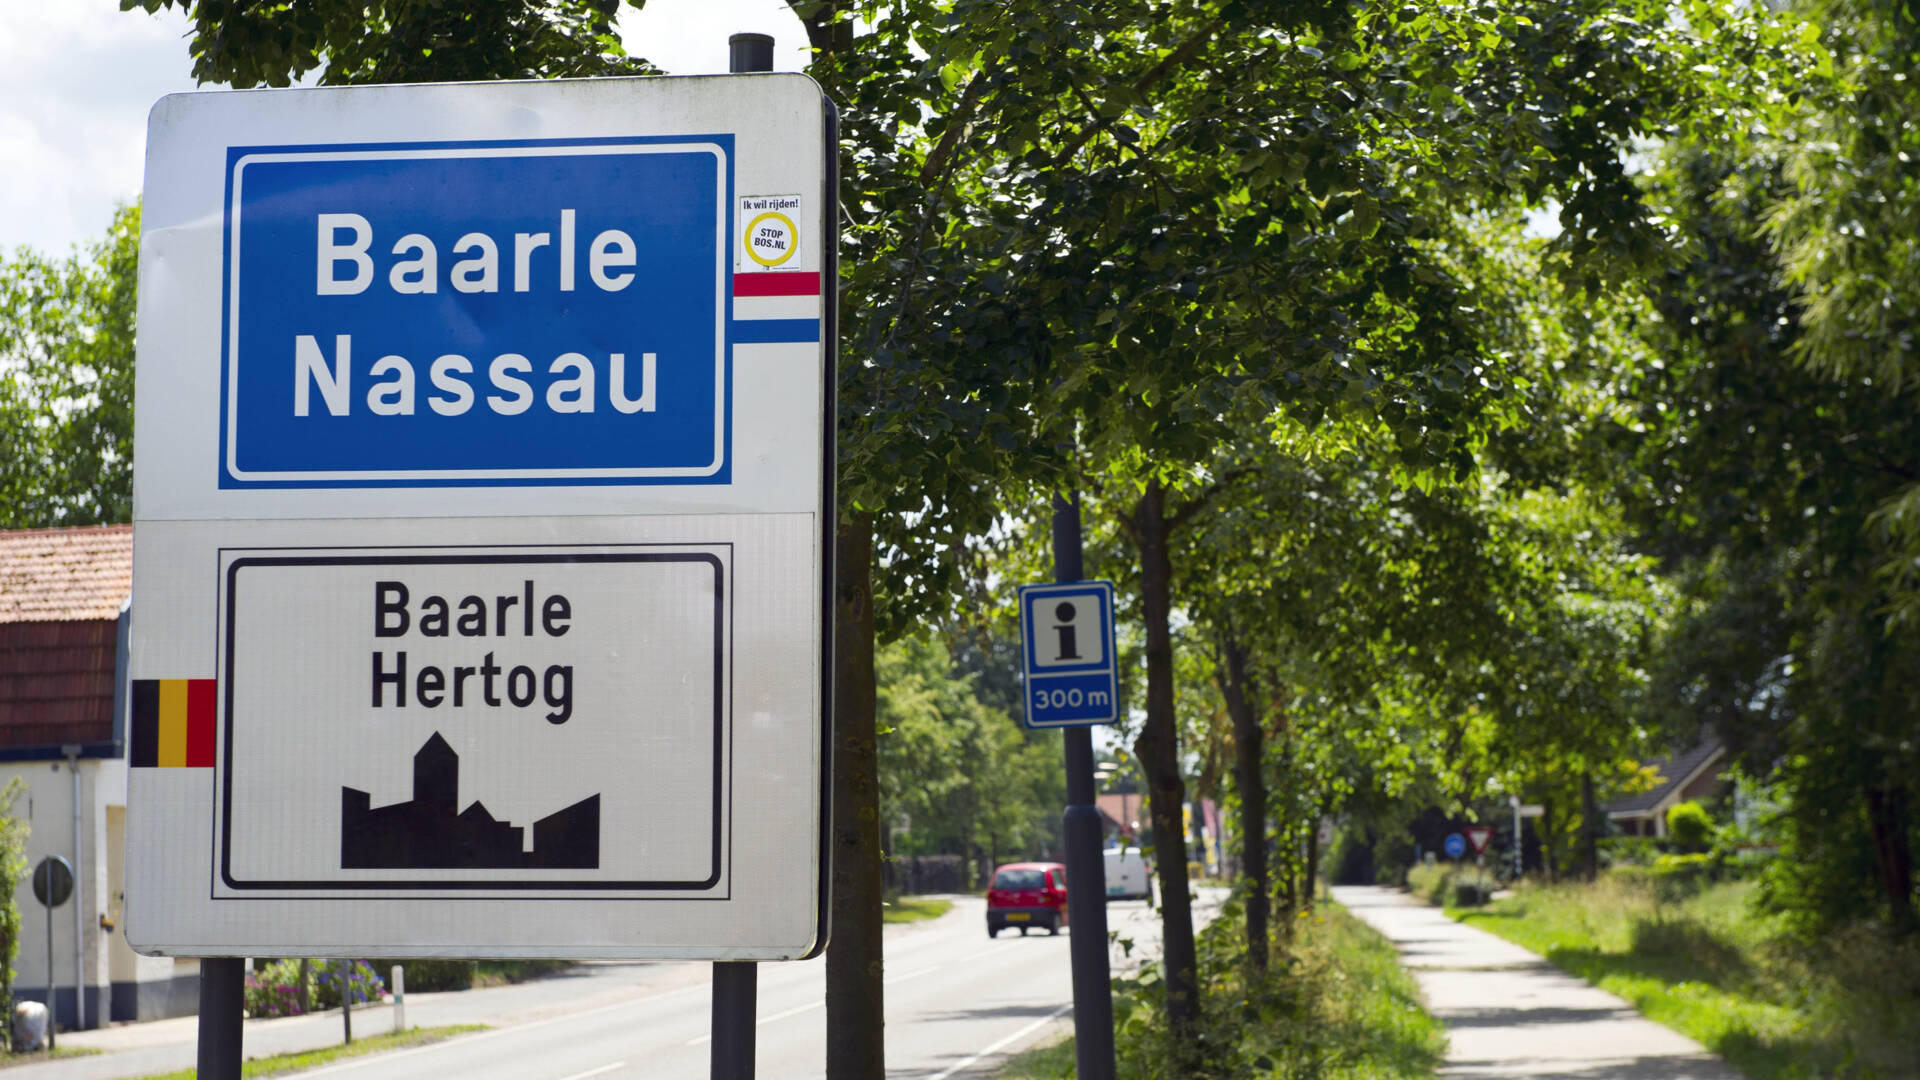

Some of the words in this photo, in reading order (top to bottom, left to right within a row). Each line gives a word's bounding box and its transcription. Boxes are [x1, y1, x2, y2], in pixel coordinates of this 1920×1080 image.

[743, 200, 752, 210] Ik
[753, 199, 767, 209] wil
[769, 198, 799, 211] rijden!
[316, 208, 637, 296] Baarle
[754, 237, 786, 250] BOS.NL
[760, 227, 784, 239] STOP
[294, 334, 657, 417] Nassau
[374, 579, 572, 638] Baarle
[371, 651, 574, 725] Hertog
[1034, 688, 1083, 709] 300
[1088, 690, 1108, 707] m
